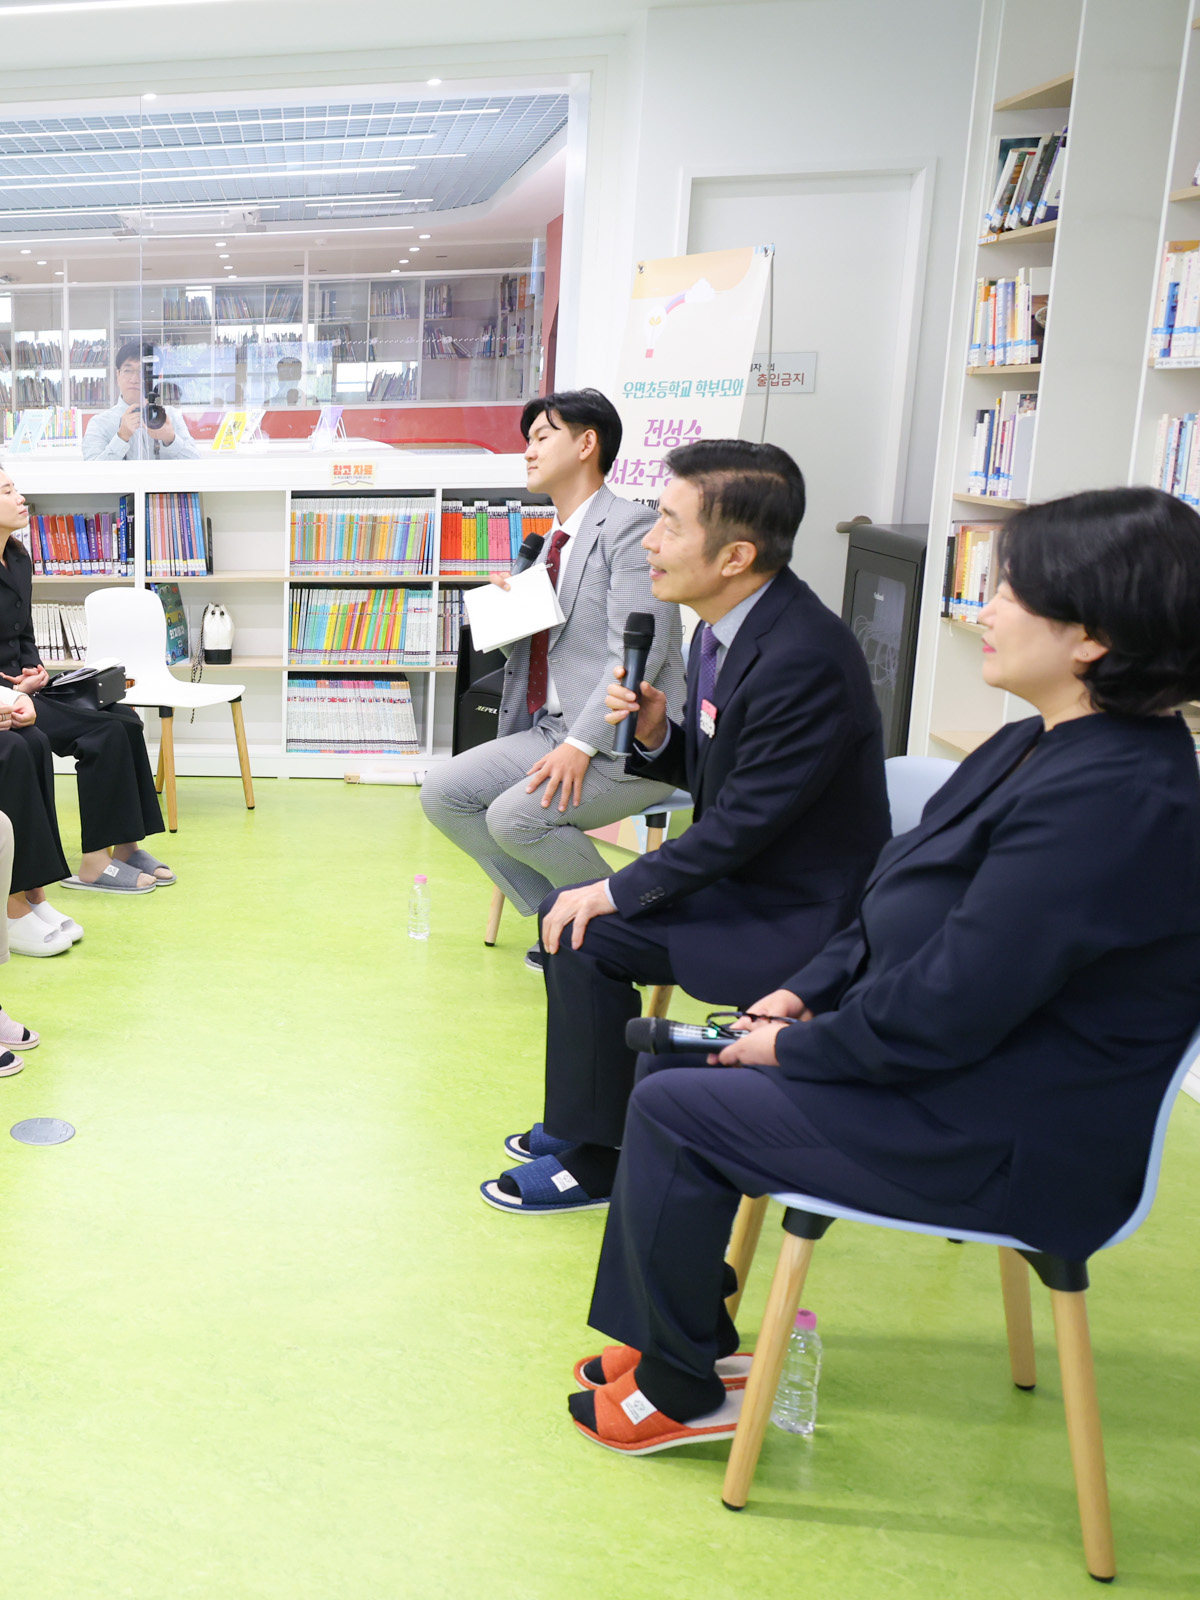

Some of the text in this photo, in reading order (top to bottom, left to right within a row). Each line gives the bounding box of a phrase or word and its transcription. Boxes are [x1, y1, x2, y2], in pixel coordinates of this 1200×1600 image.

[757, 372, 805, 387] 출입금지
[622, 378, 744, 399] 우면초등학교 학부모와
[333, 464, 373, 476] 참고 자료
